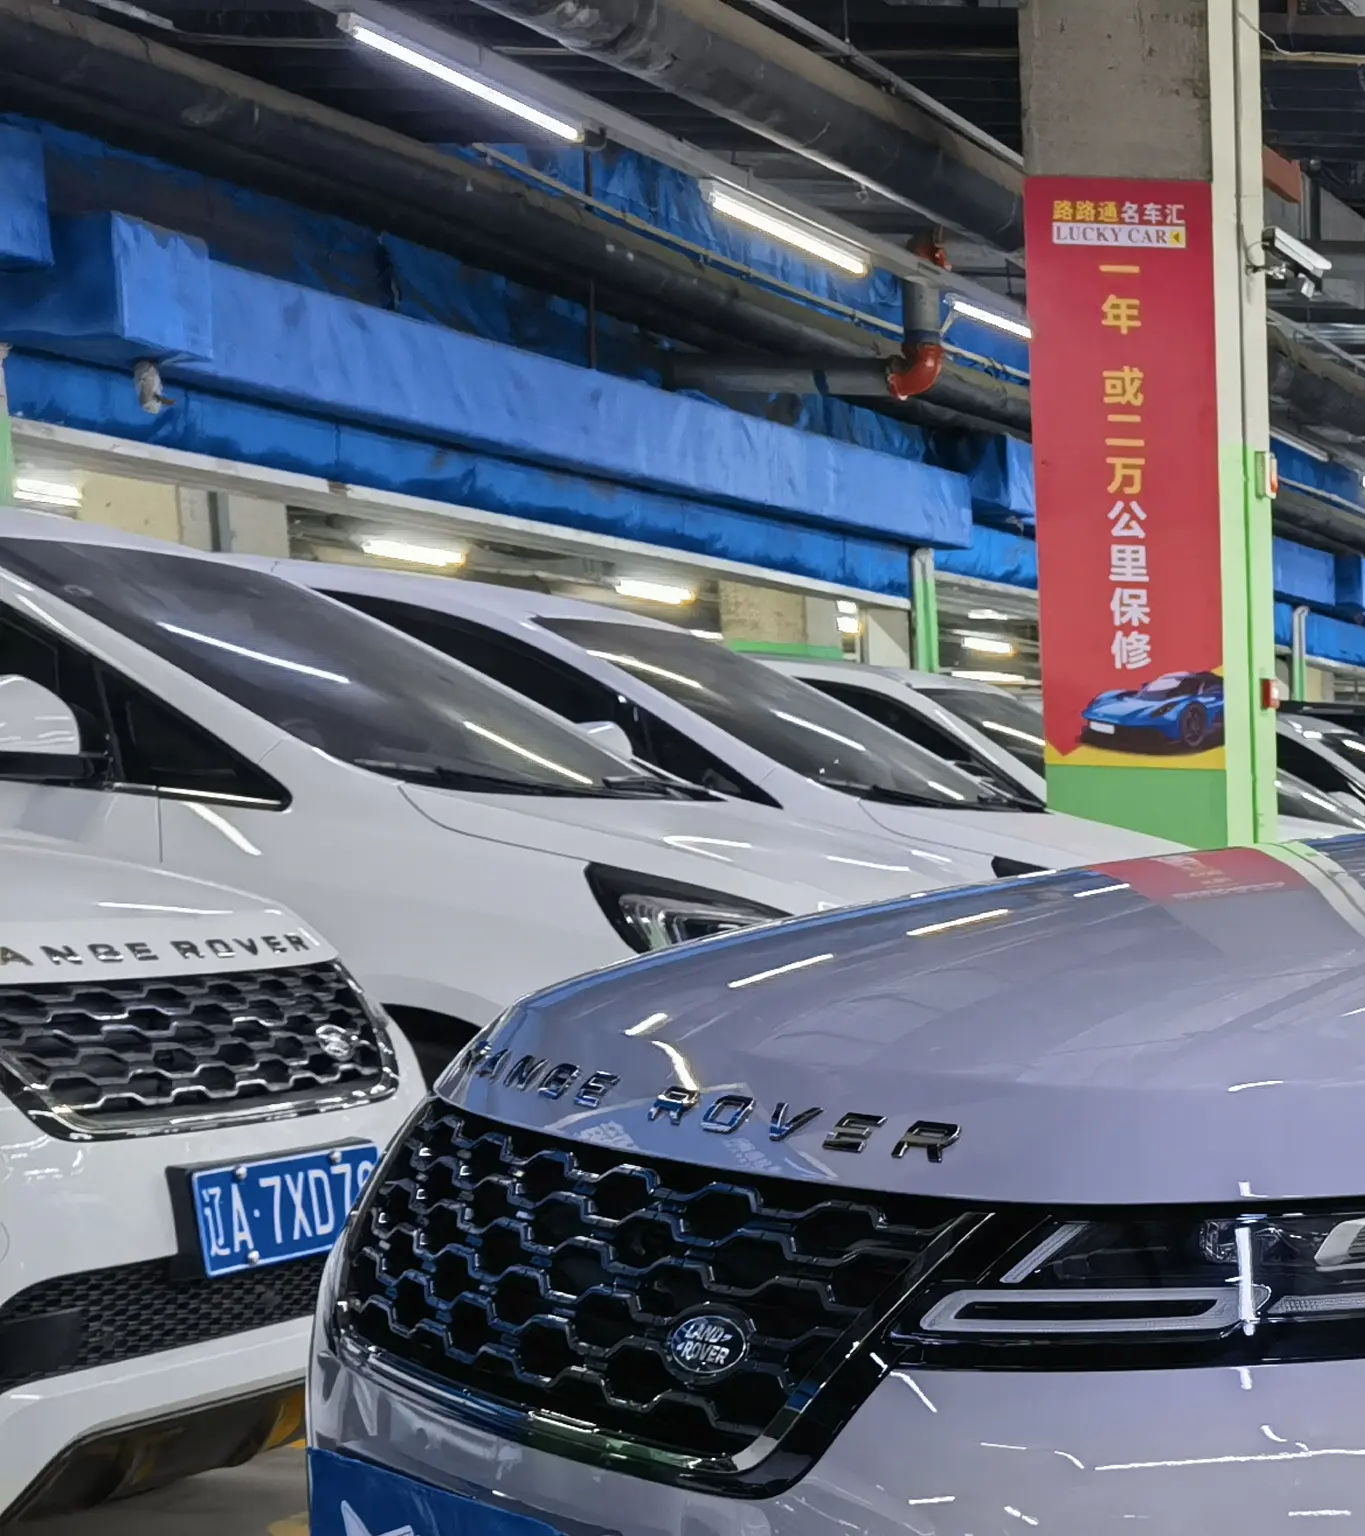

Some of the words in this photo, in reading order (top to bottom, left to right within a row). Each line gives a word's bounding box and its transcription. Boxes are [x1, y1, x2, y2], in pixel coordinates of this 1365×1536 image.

[1052, 200, 1185, 225] 路路通名车汇
[1055, 225, 1122, 242] LUCKY
[1127, 228, 1168, 244] CAR
[1099, 264, 1142, 335] 一年
[1102, 365, 1151, 670] 或二万公里保修
[169, 933, 311, 961] ROVER
[647, 1084, 962, 1163] ROVER
[684, 1323, 726, 1343] LAND
[680, 1340, 730, 1365] ROVER
